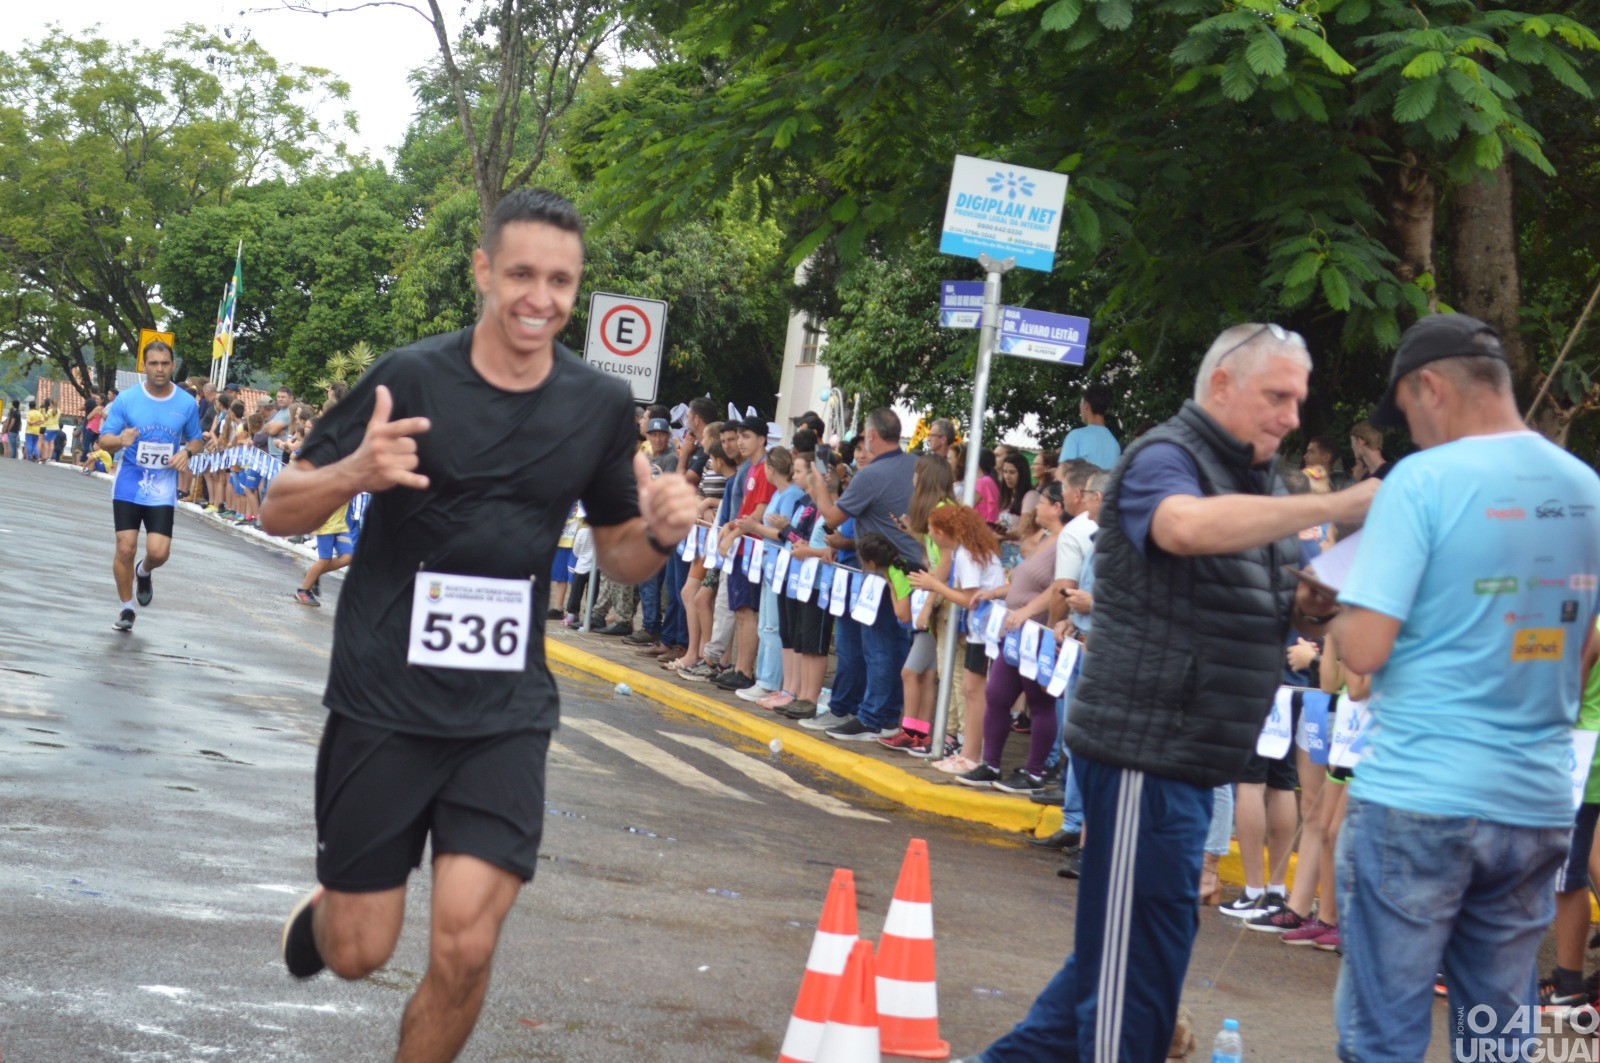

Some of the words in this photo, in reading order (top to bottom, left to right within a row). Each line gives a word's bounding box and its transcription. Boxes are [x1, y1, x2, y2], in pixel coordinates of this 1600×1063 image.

[956, 192, 1025, 219] DIGIPLAN
[1028, 206, 1056, 224] NET
[1021, 220, 1050, 231] INTERNET
[1005, 310, 1020, 319] RUA
[617, 316, 635, 344] E
[1003, 321, 1017, 332] DR.
[1019, 320, 1050, 338] ÁLVARO
[1051, 328, 1079, 343] LEITÃO
[140, 453, 170, 465] 576
[421, 611, 519, 656] 536
